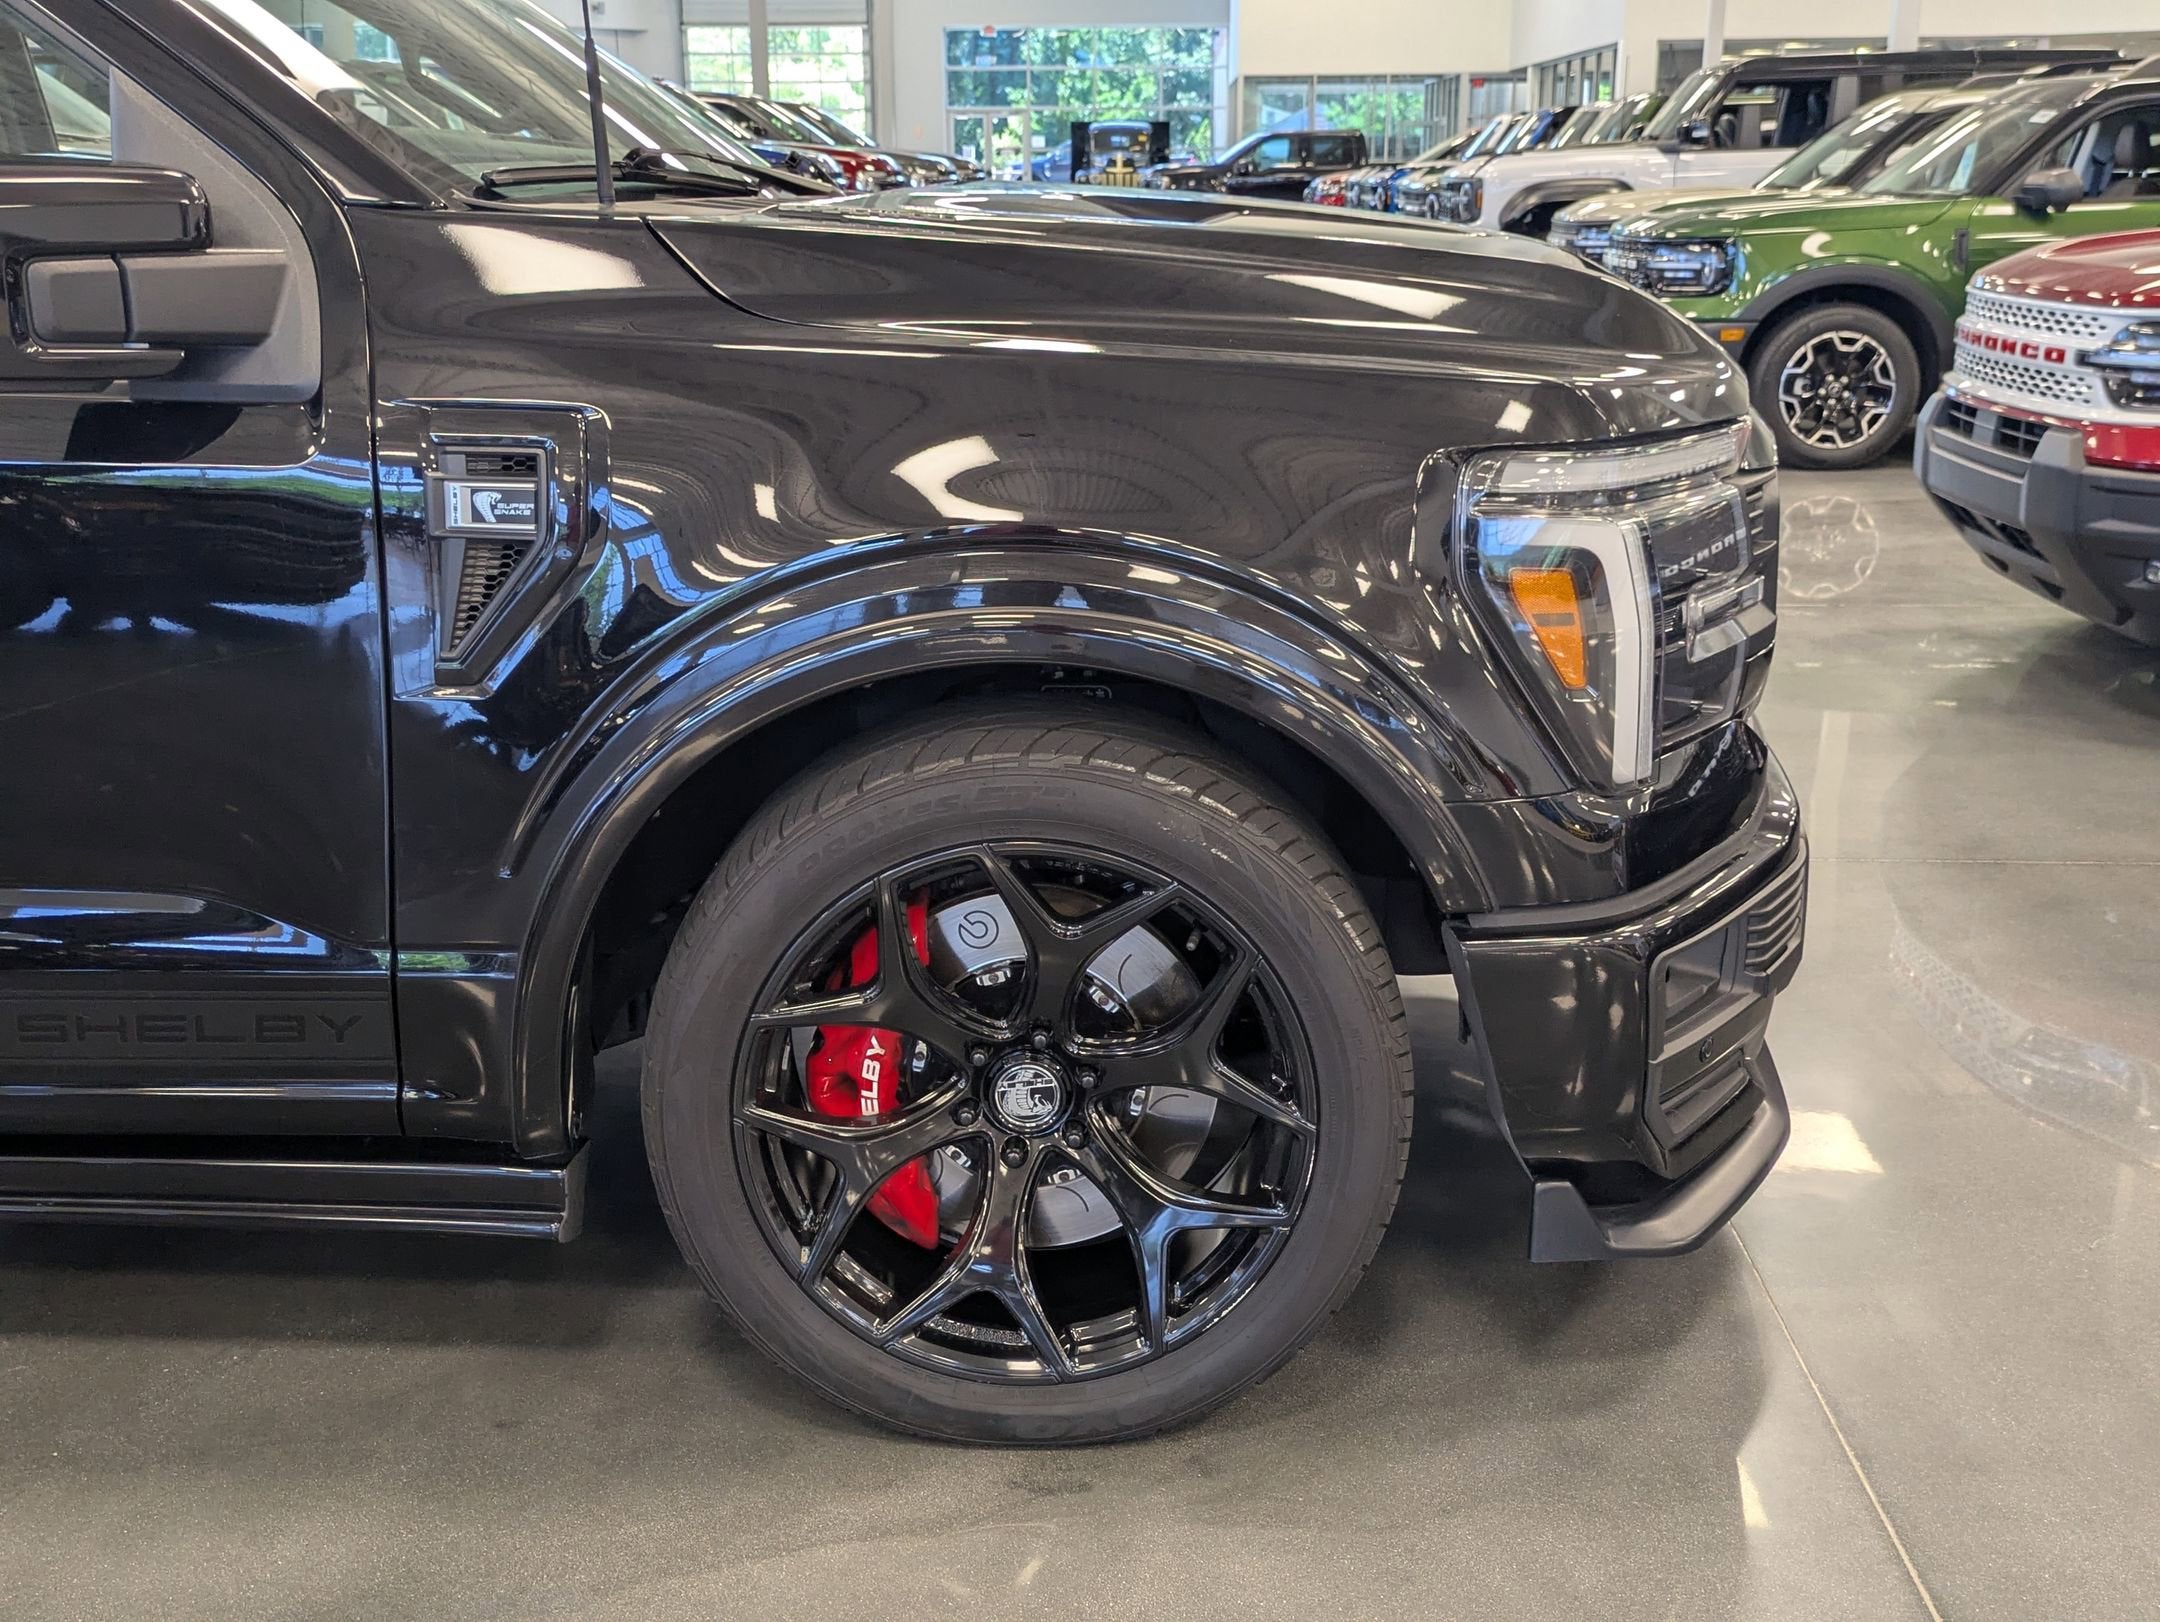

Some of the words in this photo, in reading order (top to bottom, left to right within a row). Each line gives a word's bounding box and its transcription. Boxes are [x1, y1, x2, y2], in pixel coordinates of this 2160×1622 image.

[451, 486, 459, 525] SHELBY
[493, 508, 532, 516] SNAKE
[496, 502, 535, 510] SUPER
[17, 1014, 363, 1044] SHELBY
[860, 1035, 886, 1117] ELBY
